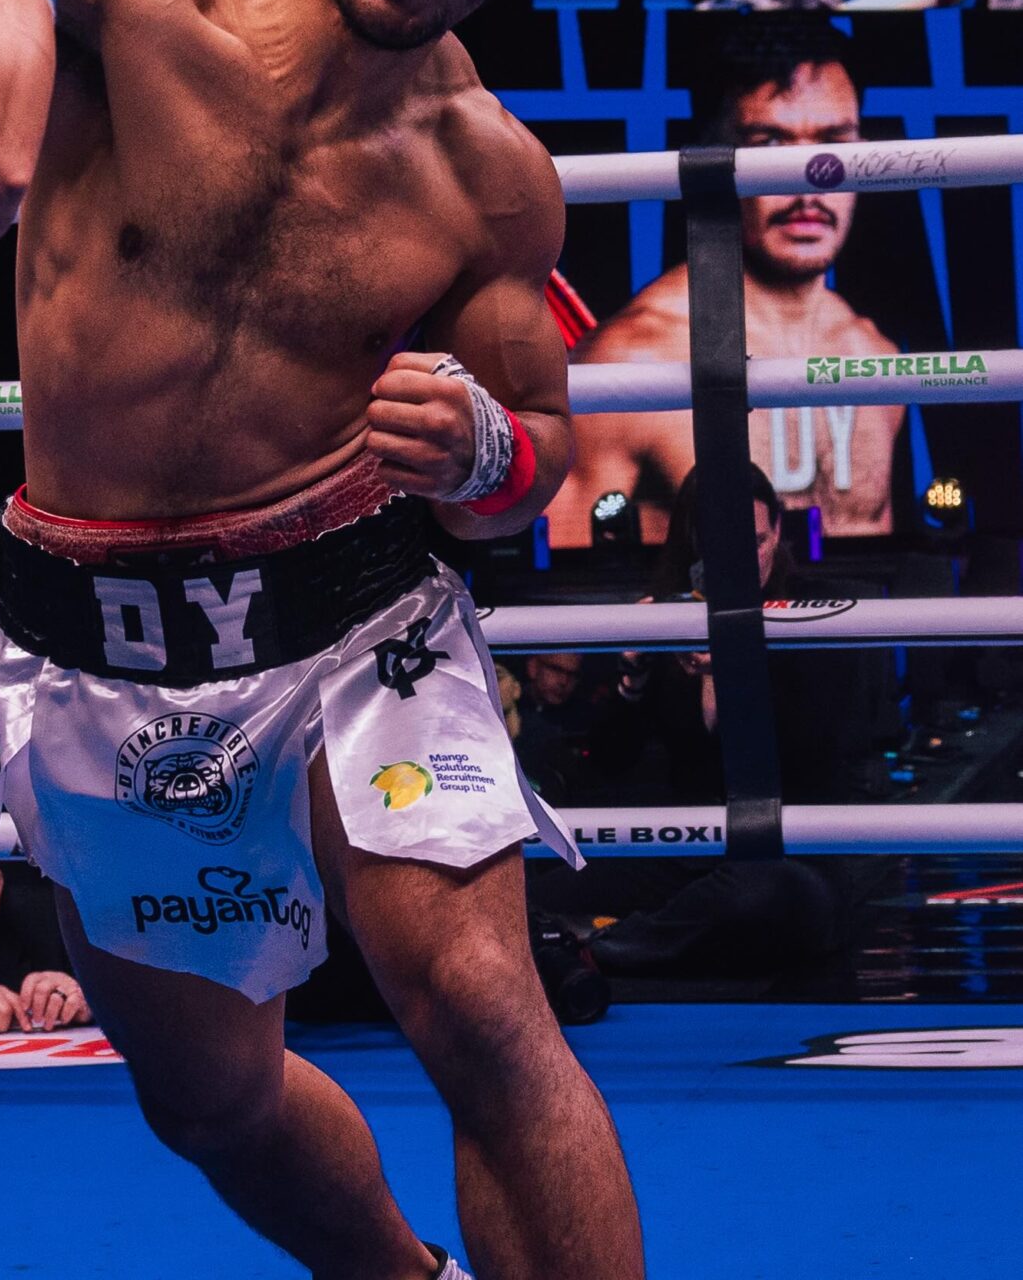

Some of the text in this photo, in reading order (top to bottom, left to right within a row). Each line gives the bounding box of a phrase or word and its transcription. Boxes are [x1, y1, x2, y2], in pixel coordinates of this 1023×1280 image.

[858, 176, 947, 186] COMPETITIONS
[845, 355, 986, 377] ESTRELLA
[920, 377, 987, 388] INSURANCE
[119, 716, 256, 790] DYINCREDIBLE
[429, 753, 469, 768] Mango
[432, 763, 482, 778] Solutions
[436, 773, 496, 786] Recruitment
[439, 782, 487, 794] Group Ltd
